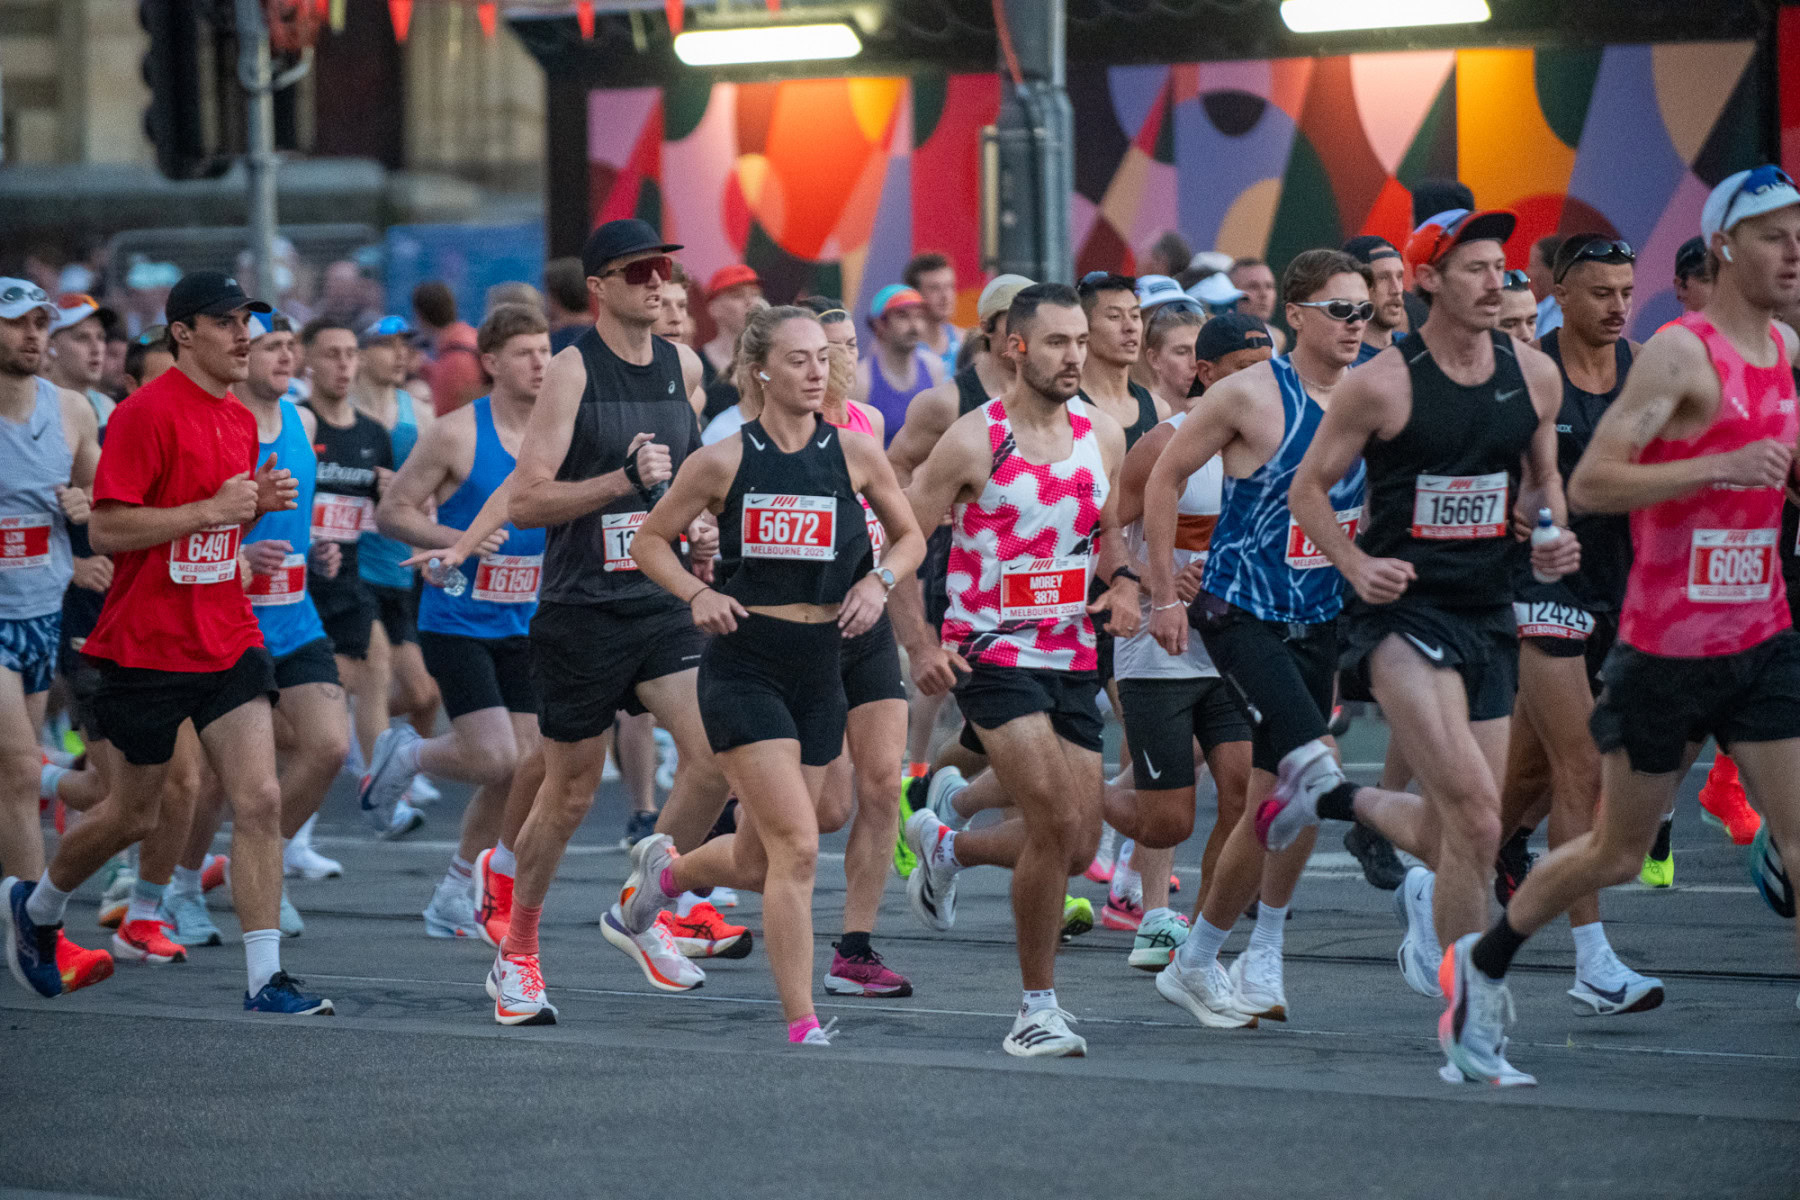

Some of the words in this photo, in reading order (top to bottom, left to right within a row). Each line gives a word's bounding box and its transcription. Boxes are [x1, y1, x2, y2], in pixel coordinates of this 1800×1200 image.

[1430, 494, 1498, 525] 15667
[758, 511, 819, 544] 5672
[188, 532, 231, 561] 6491
[750, 545, 802, 556] MELBOURNE
[804, 547, 825, 557] 2025
[178, 563, 218, 573] MELBOURNE
[1709, 548, 1765, 584] 6085
[488, 567, 534, 592] 16150
[1029, 574, 1064, 590] MOREY
[1034, 590, 1060, 605] 3879
[1009, 606, 1059, 617] MELBOURNE
[1061, 604, 1080, 614] 2025
[1527, 601, 1588, 630] 12424
[1522, 625, 1568, 637] MELBOURNE
